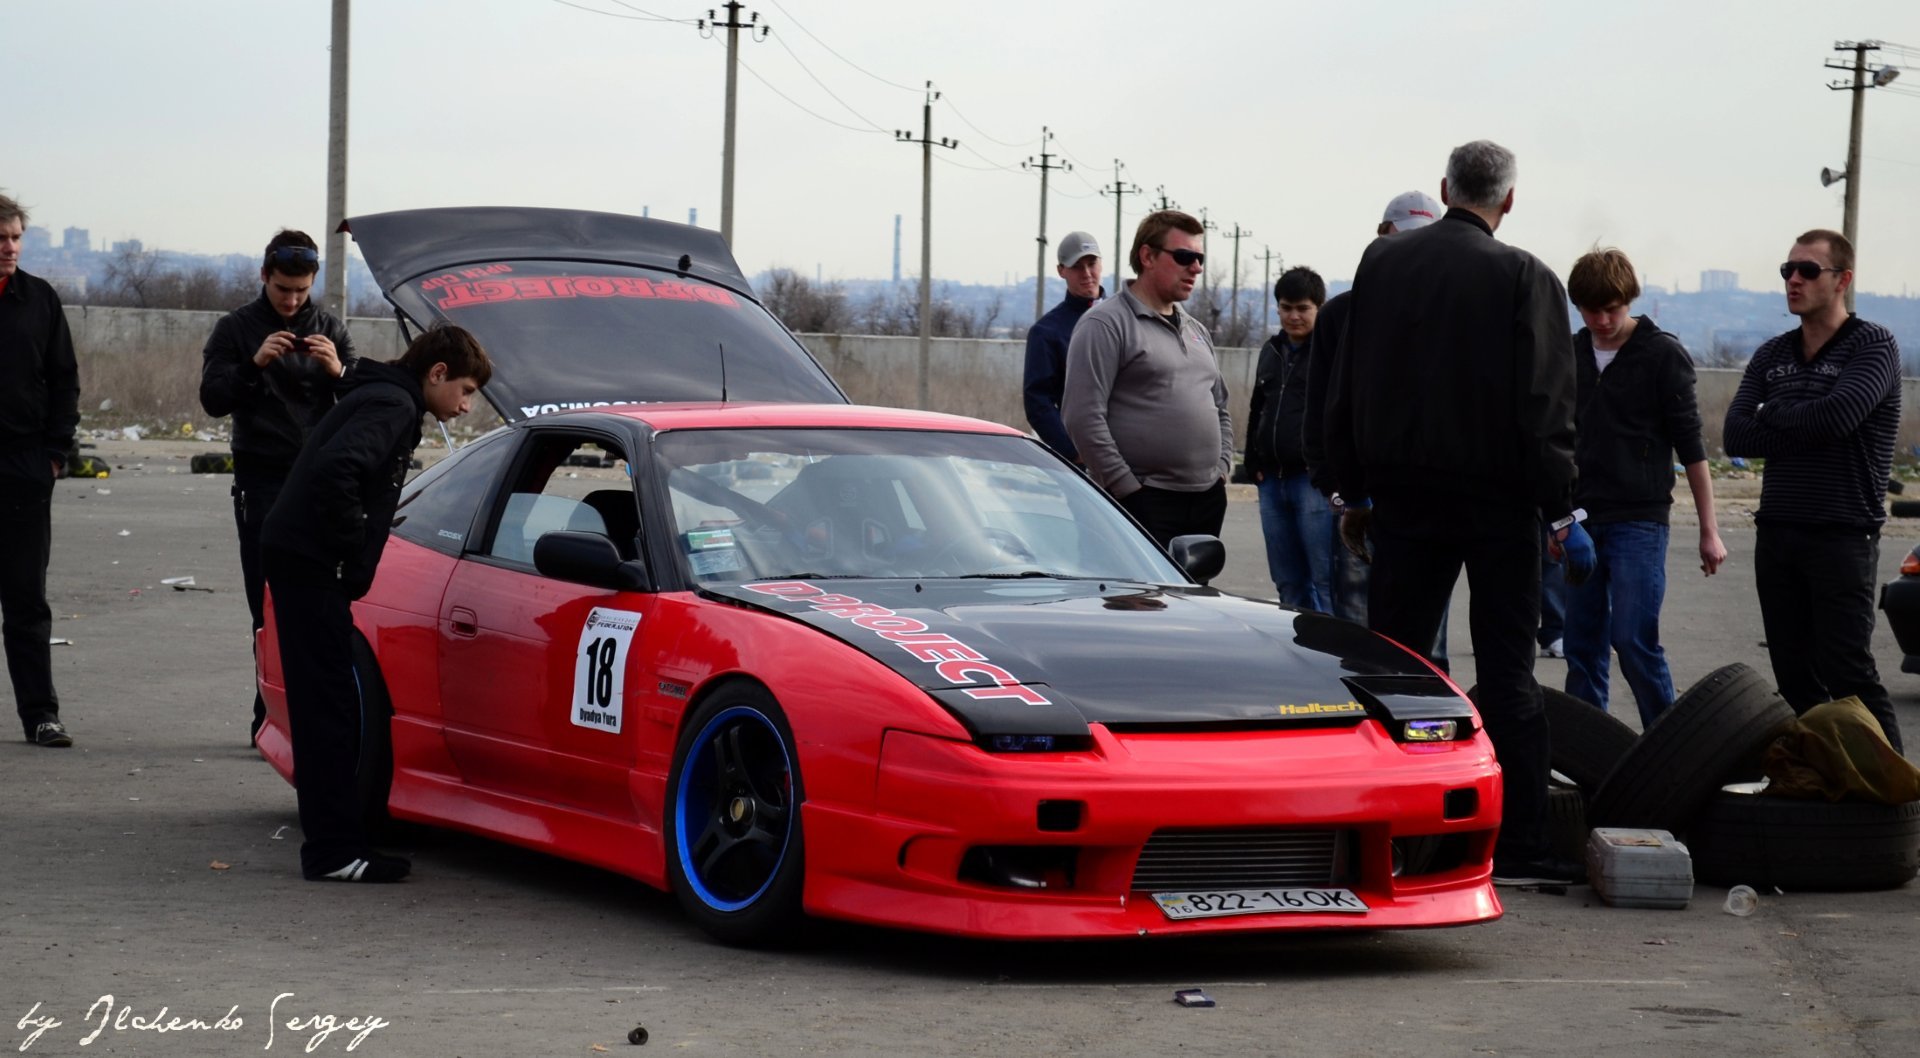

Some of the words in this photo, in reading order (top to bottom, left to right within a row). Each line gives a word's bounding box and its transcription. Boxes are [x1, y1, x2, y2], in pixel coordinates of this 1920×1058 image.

[459, 264, 513, 279] OPEN
[421, 274, 460, 291] CUP
[597, 621, 634, 632] FEDERATION
[586, 636, 617, 709] 18
[1279, 701, 1364, 716] Haltech
[579, 707, 602, 724] Dyadya
[602, 711, 617, 727] Yura
